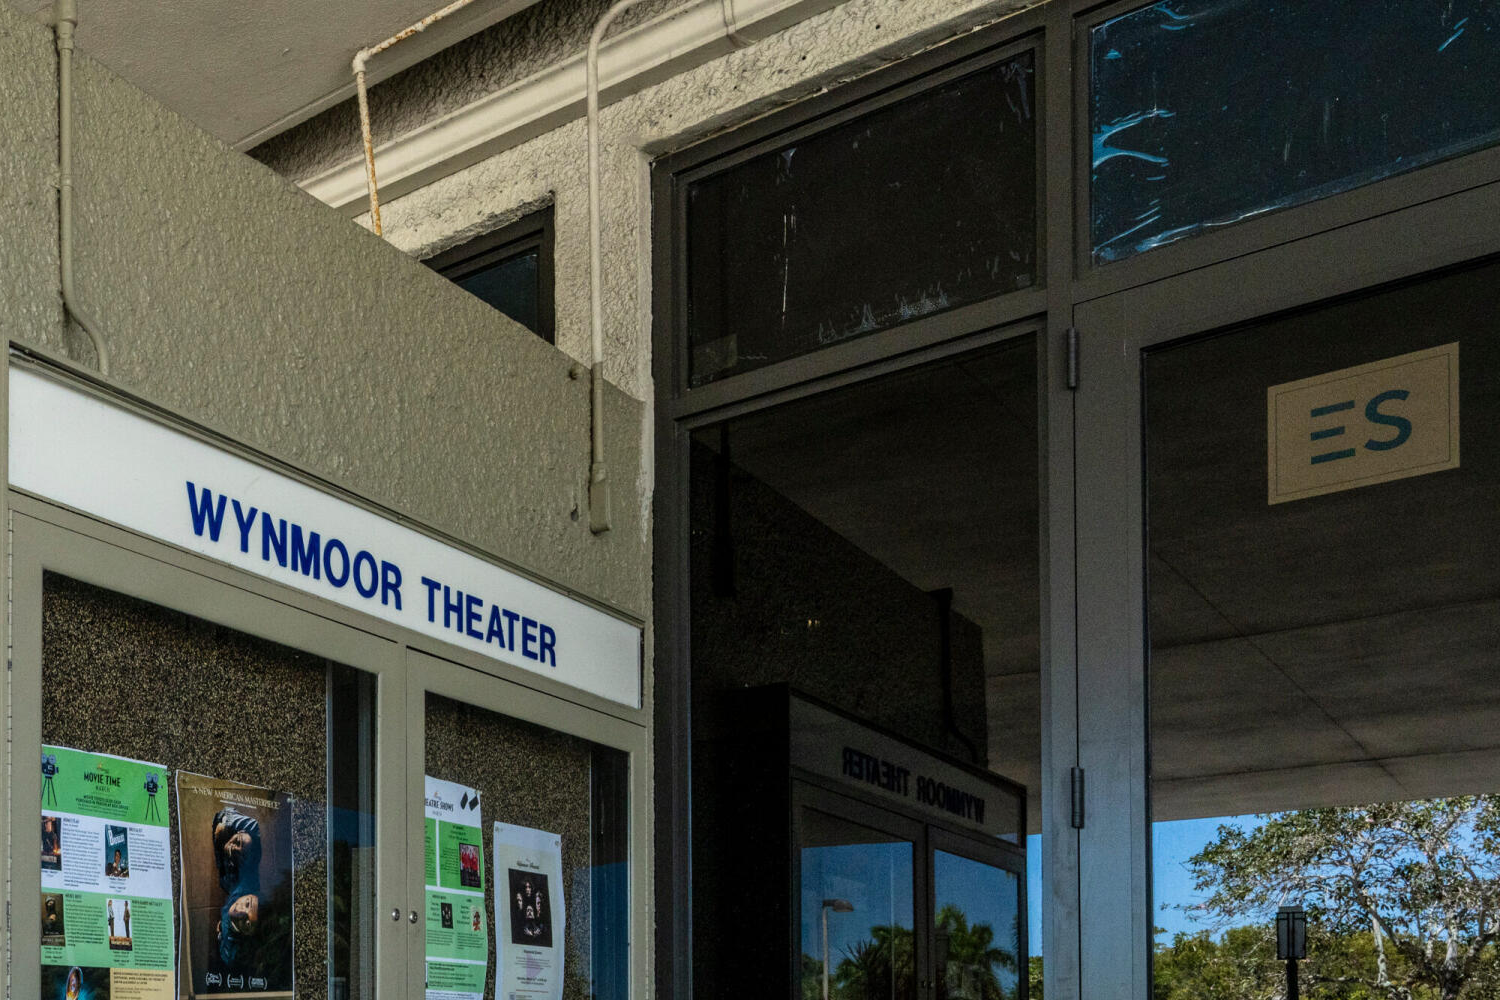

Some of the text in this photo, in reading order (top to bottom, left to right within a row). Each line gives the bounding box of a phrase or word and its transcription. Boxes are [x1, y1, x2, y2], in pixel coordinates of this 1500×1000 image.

[186, 481, 557, 667] WYNMOOR THEATER
[84, 771, 121, 788] MOVIE TIME
[200, 787, 213, 796] NEW
[214, 790, 245, 802] AMERICAN
